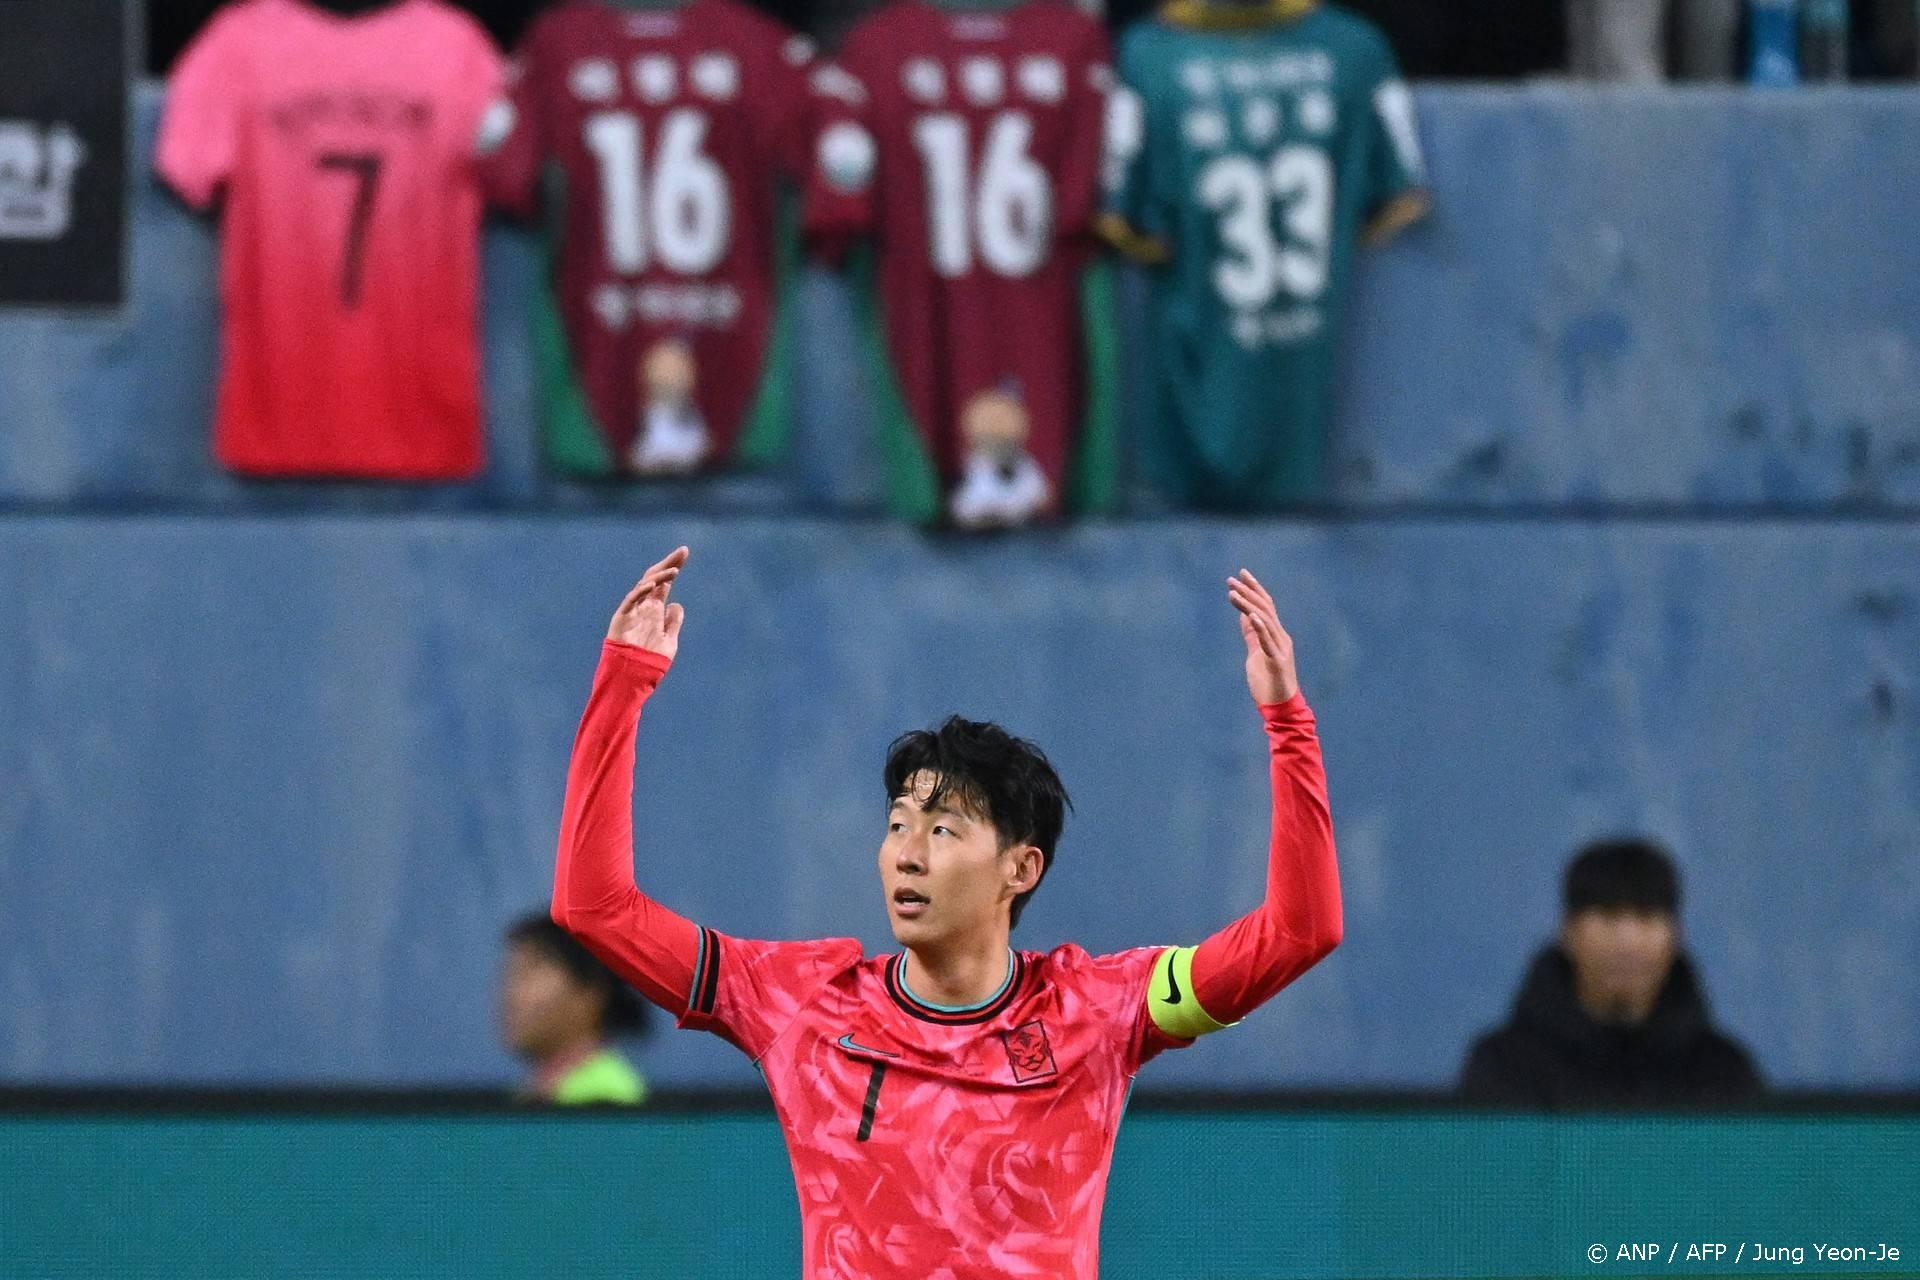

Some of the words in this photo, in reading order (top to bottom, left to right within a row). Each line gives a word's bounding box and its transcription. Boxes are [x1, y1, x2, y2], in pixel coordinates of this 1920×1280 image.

[316, 151, 383, 308] 7
[584, 110, 732, 274] 16
[915, 112, 1053, 277] 16
[1199, 145, 1335, 308] 33
